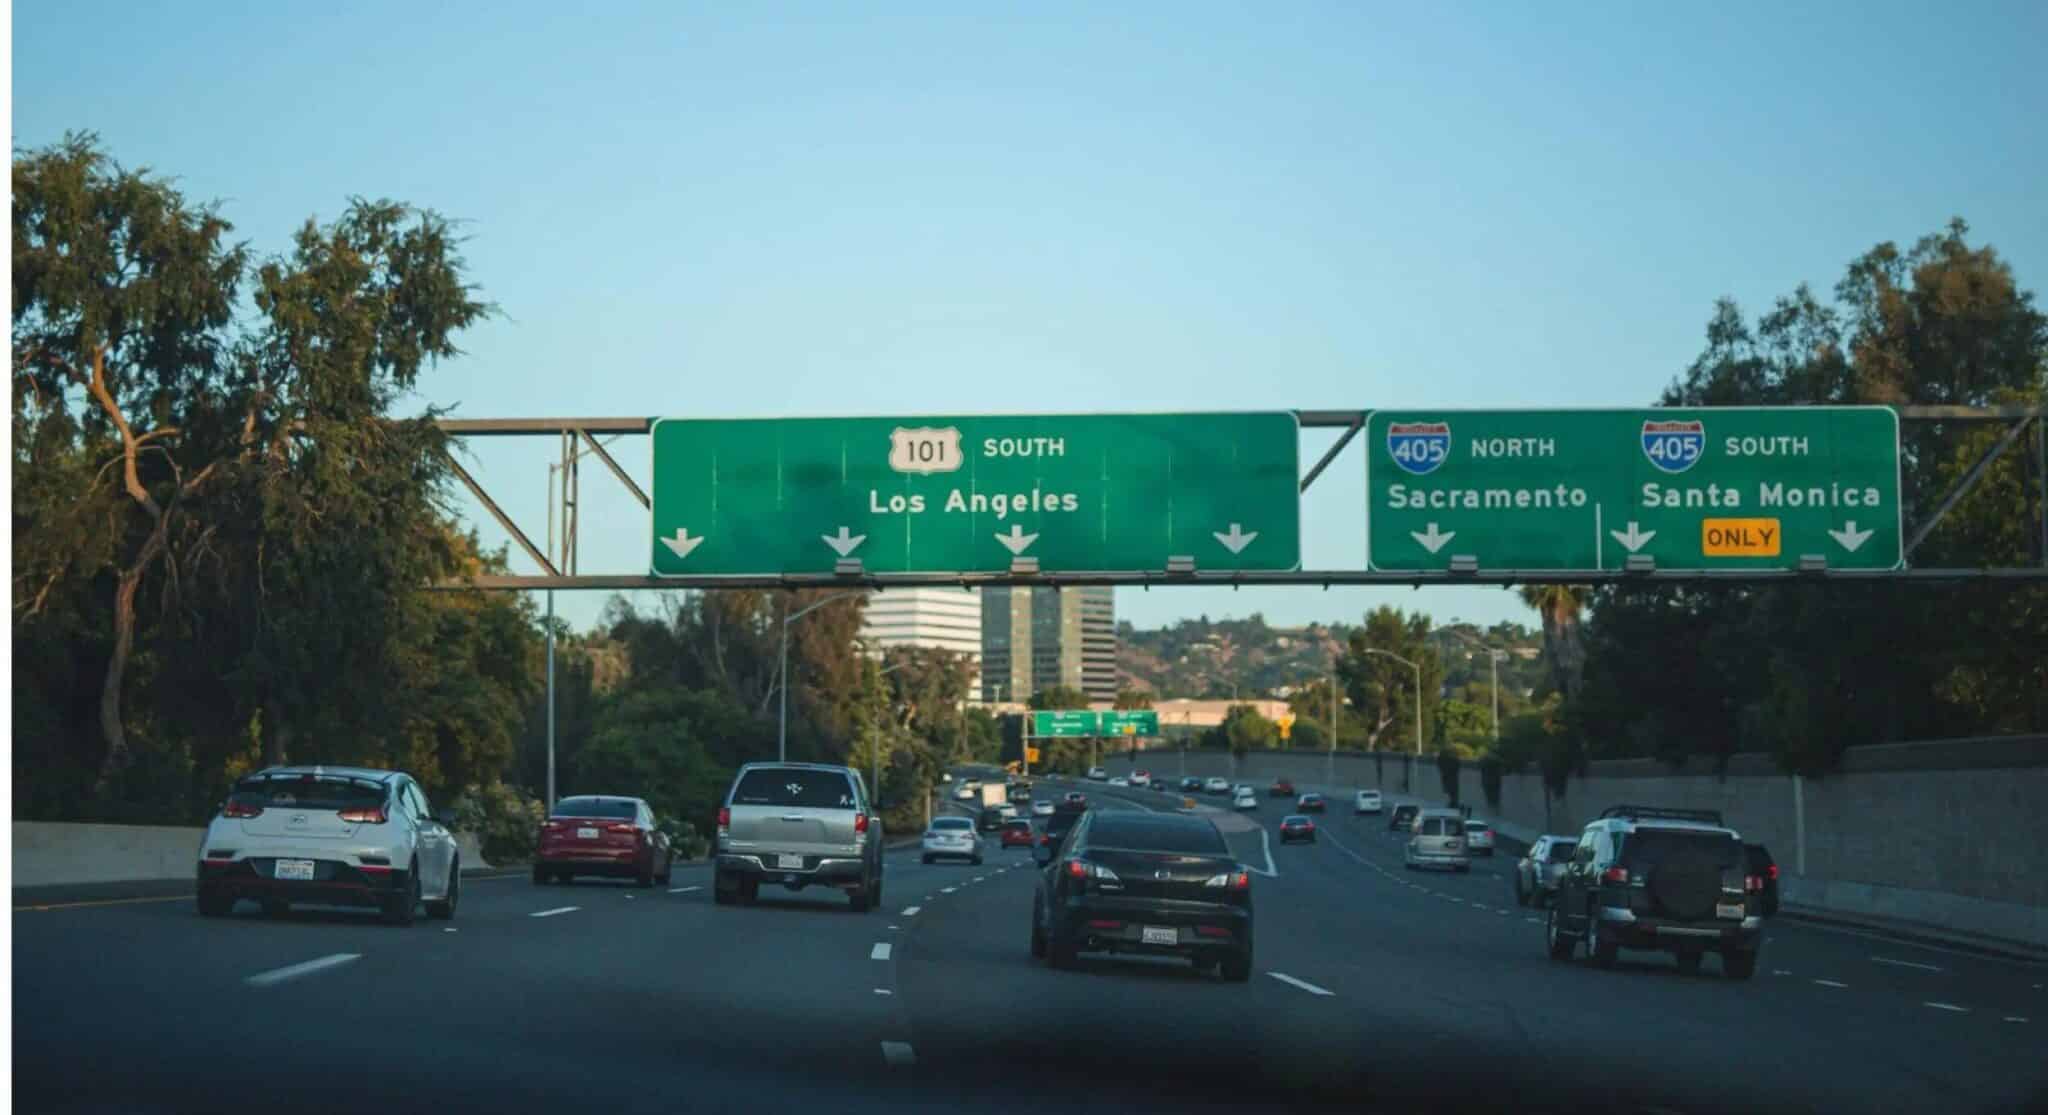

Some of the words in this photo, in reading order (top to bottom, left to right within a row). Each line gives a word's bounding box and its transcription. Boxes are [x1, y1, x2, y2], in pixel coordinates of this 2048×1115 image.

[908, 440, 945, 462] 101
[983, 437, 1065, 458] SOUTH
[1394, 438, 1444, 463] 405
[1471, 437, 1555, 458] NORTH
[1648, 436, 1699, 461] 405
[1725, 436, 1809, 457] SOUTH
[869, 489, 926, 514] Los
[945, 488, 1080, 520] Angeles
[1388, 483, 1587, 509] Sacramento
[1642, 482, 1741, 508] Santa
[1759, 482, 1881, 507] Monica
[1707, 527, 1774, 548] ONLY
